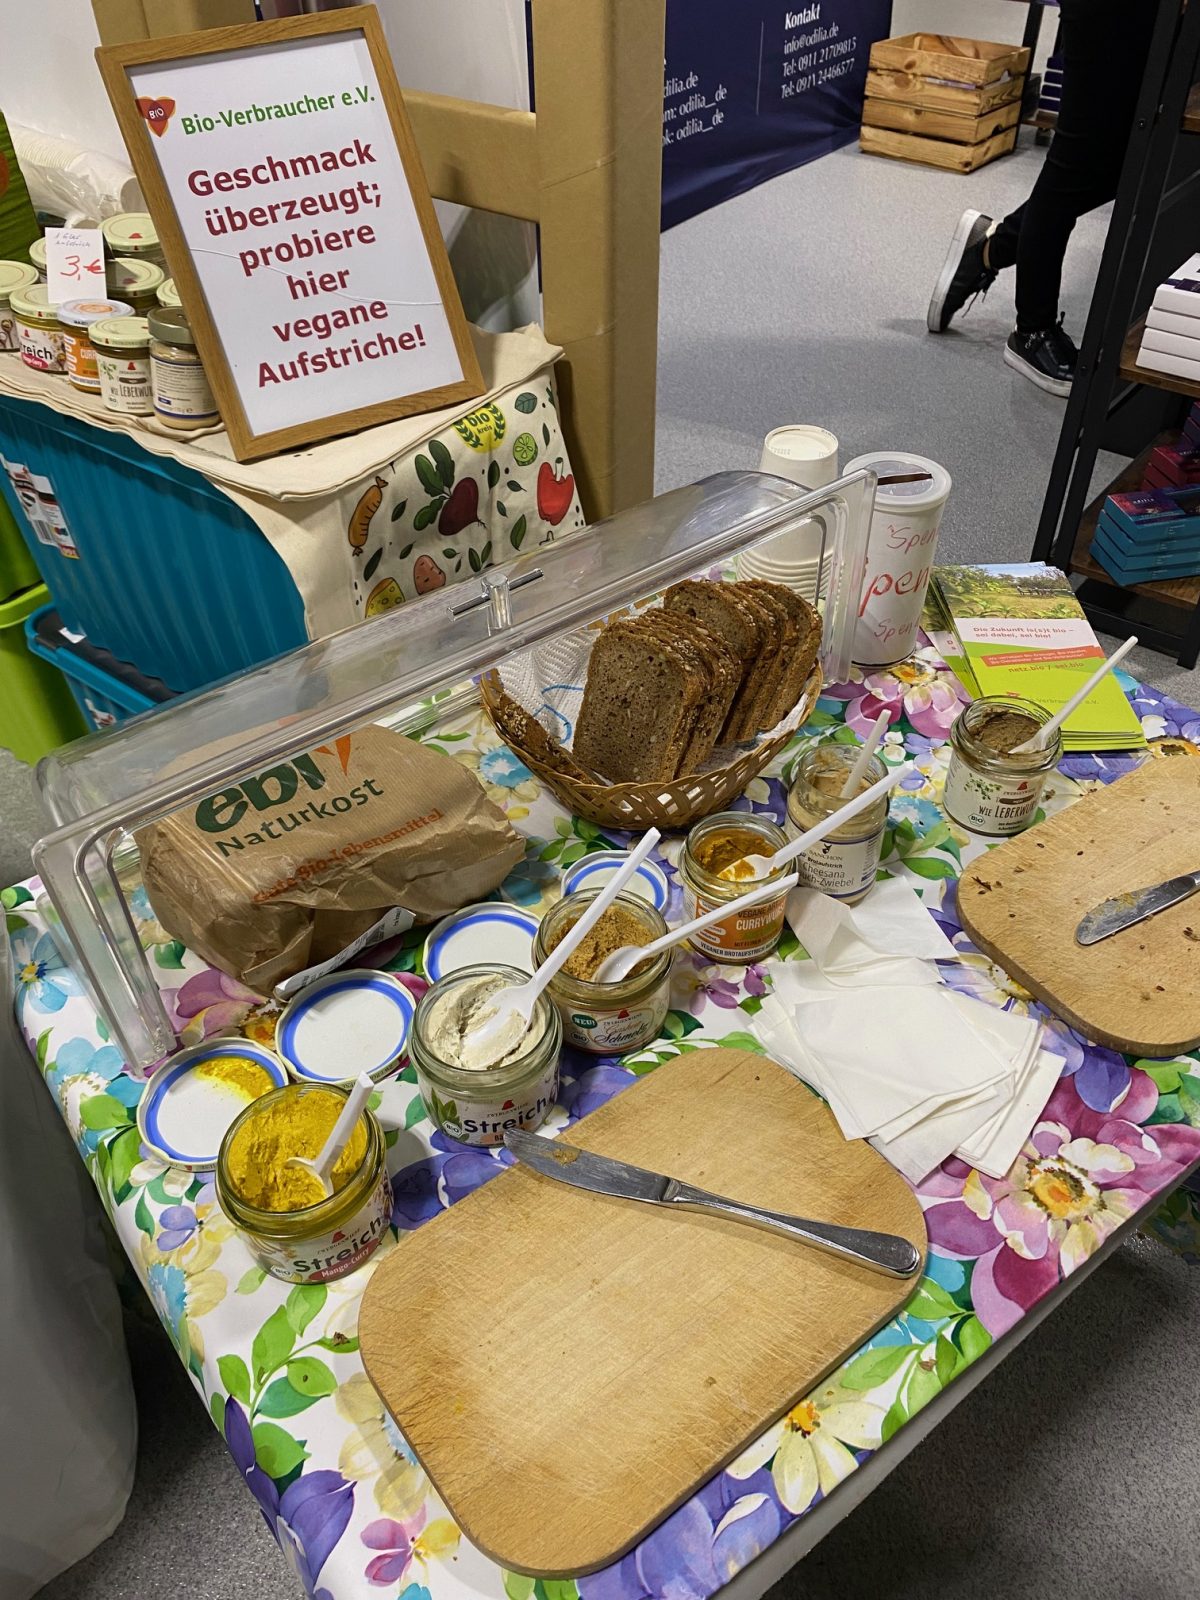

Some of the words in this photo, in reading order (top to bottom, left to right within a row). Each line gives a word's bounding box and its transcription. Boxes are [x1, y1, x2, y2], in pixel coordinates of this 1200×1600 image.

[785, 4, 821, 30] Kontakt
[782, 62, 796, 77] Tel:
[798, 52, 817, 72] 0911
[819, 37, 857, 63] 21709815
[783, 22, 839, 55] info@odilia.de
[781, 84, 796, 99] Tel:
[796, 74, 816, 94] 0911
[818, 58, 855, 84] 24466577
[148, 107, 165, 120] BIO
[181, 92, 335, 136] Bio-Verbraucher
[341, 86, 376, 105] e.V.
[187, 138, 377, 197] Geschmack
[204, 181, 383, 237] überzeugt;
[239, 224, 376, 277] probiere
[286, 268, 351, 300] hier
[272, 299, 389, 343] vegane
[21, 341, 53, 361] reich
[258, 324, 427, 388] Aufstriche!
[466, 411, 491, 427] bio
[857, 565, 929, 618] pen
[215, 778, 385, 857] Naturkost
[297, 808, 445, 881] Bio-Lebensmittel
[803, 862, 845, 878] Cheesana
[574, 1017, 596, 1026] NEU!
[464, 1097, 547, 1133] Streich
[293, 1217, 382, 1273] Streich
[321, 1247, 370, 1278] Mango-Curry
